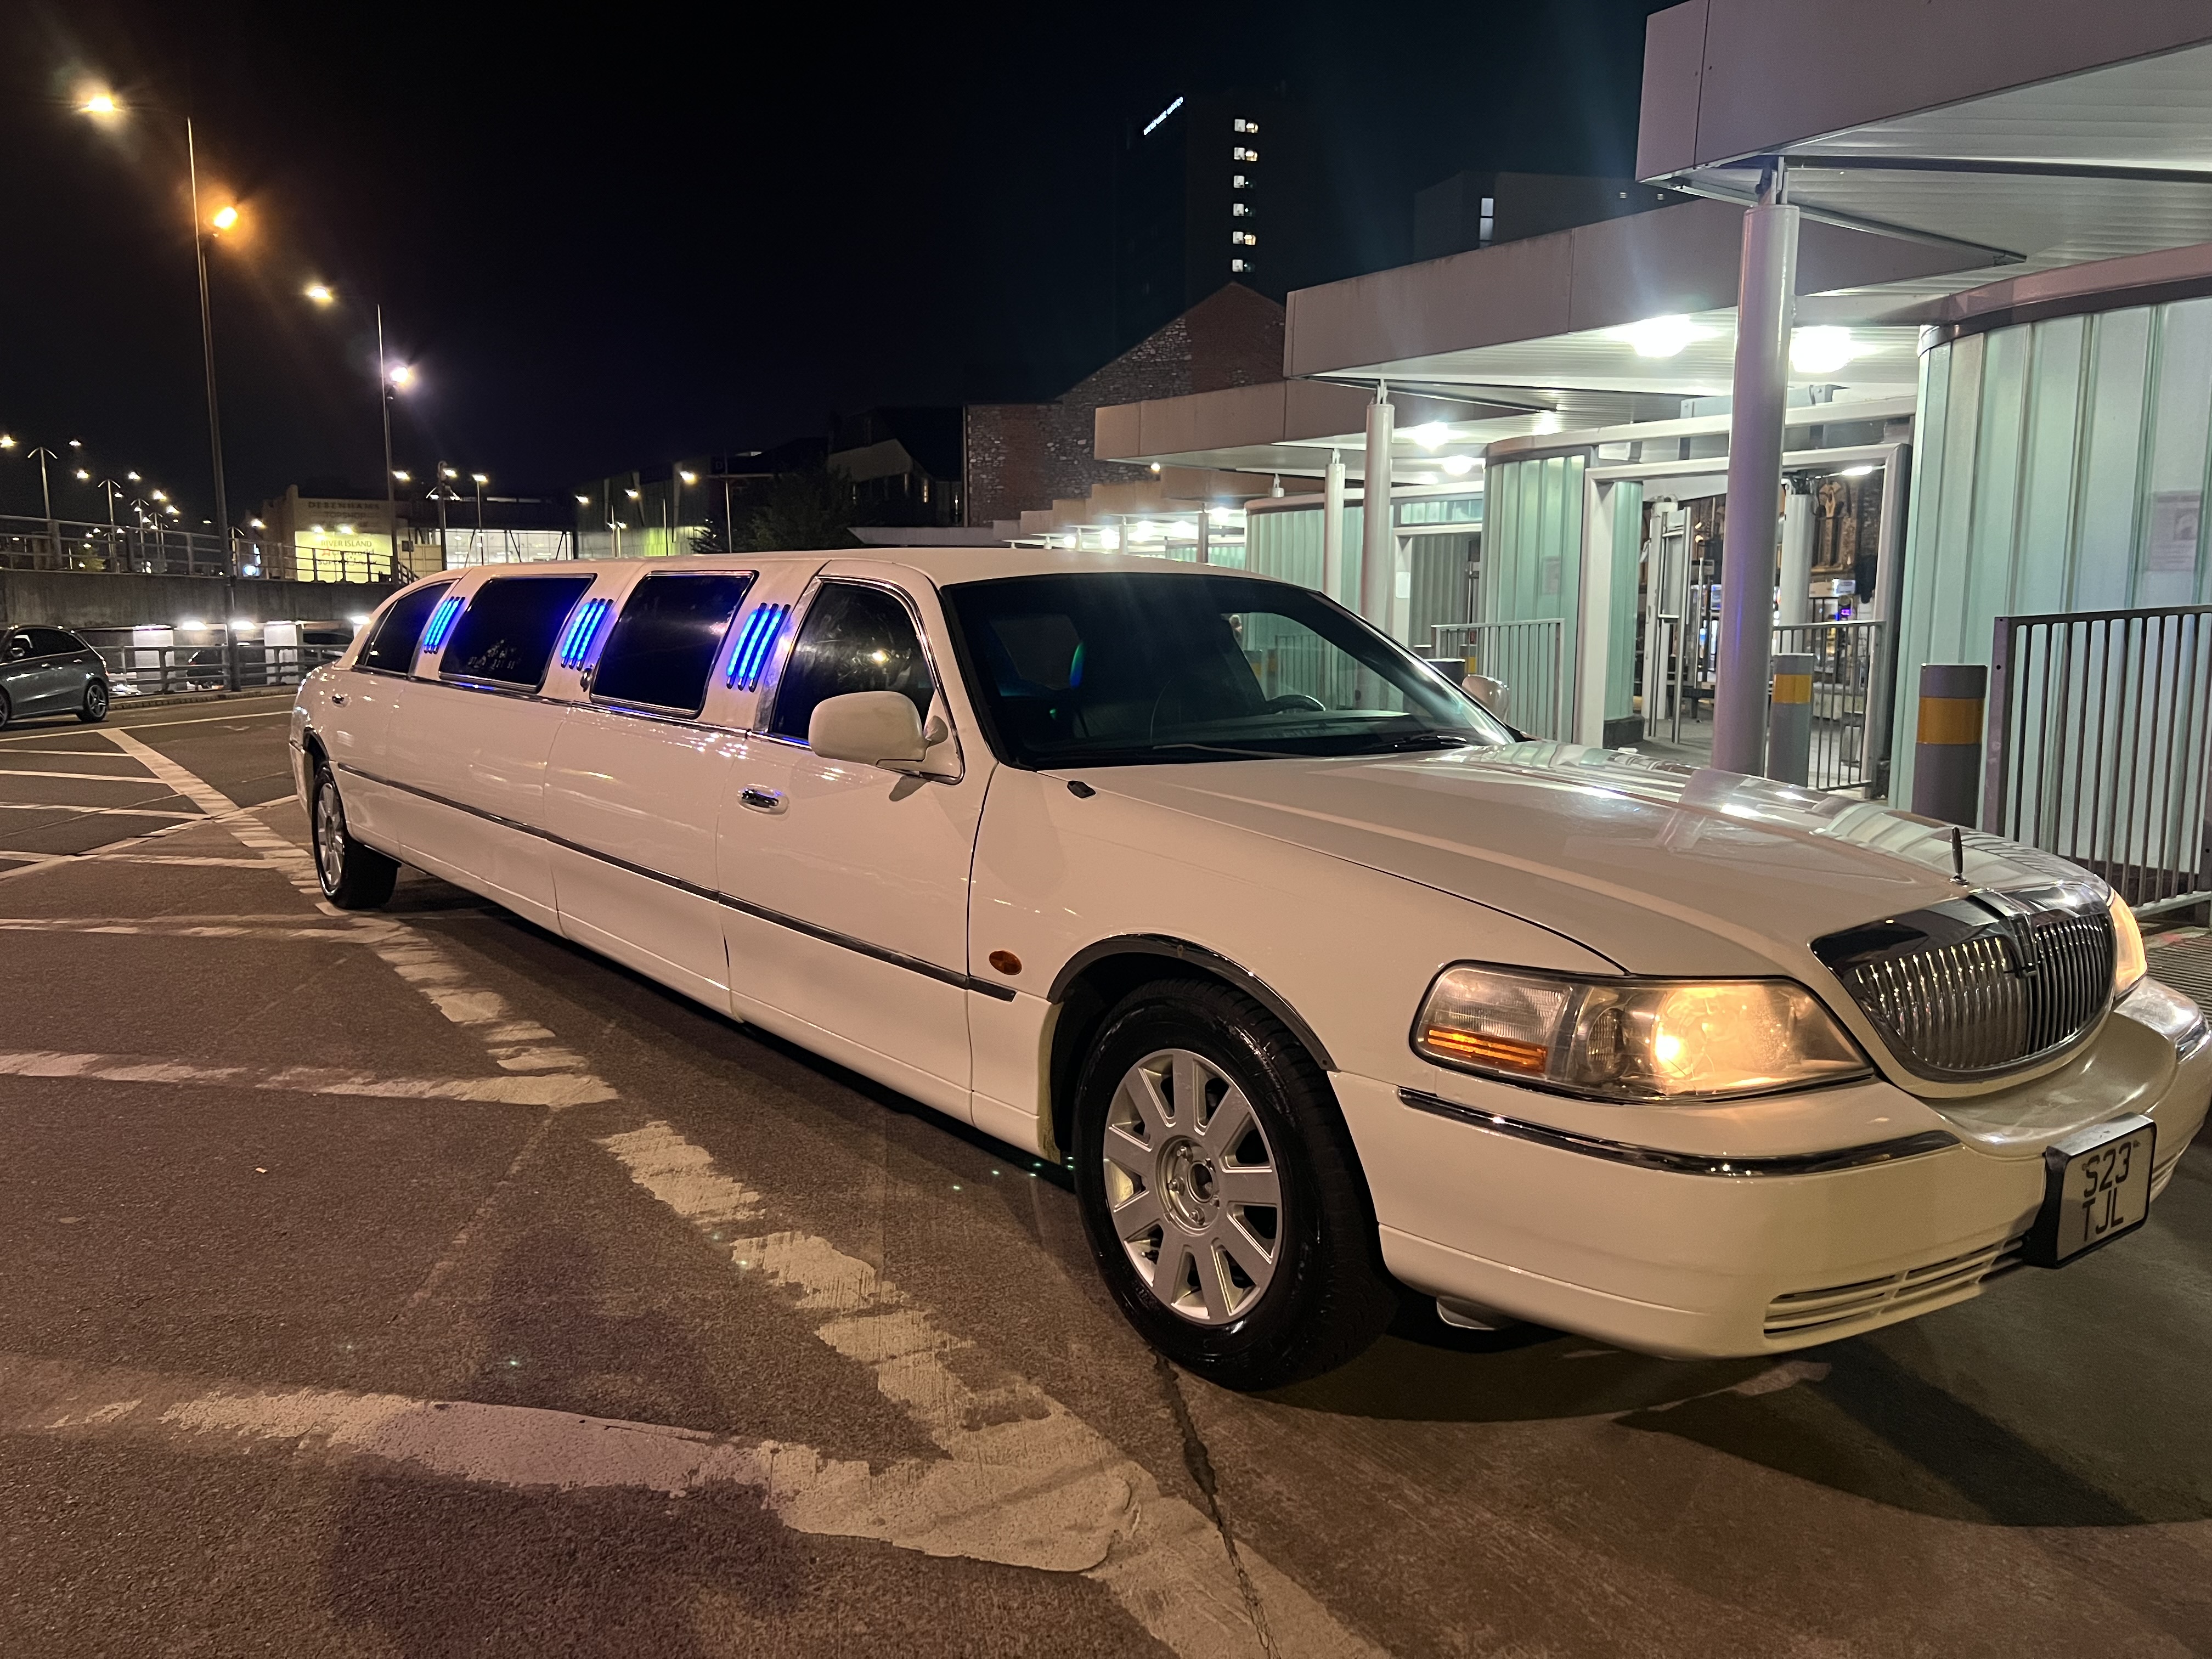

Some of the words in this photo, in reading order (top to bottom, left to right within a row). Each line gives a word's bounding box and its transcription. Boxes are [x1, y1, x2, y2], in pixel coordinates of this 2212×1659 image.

[308, 501, 380, 510] DEBENHAMS
[324, 511, 366, 520] TOPSHOP
[2084, 1142, 2132, 1198] S23
[2082, 1187, 2124, 1242] TJL
